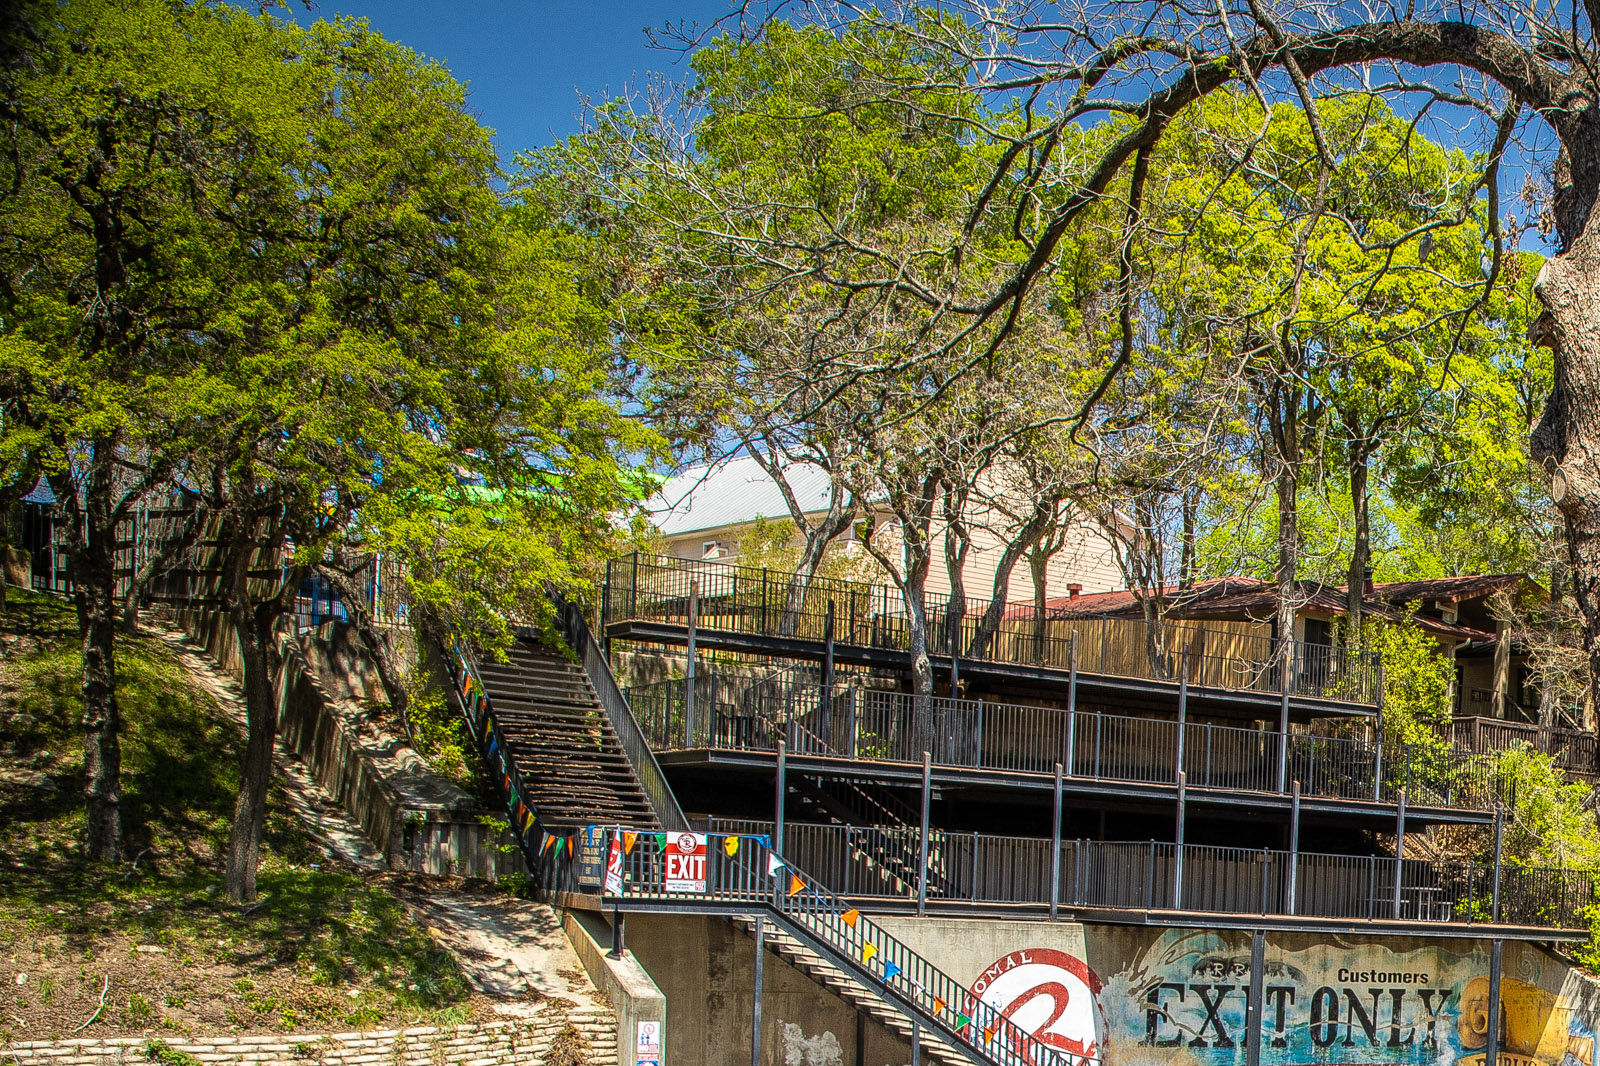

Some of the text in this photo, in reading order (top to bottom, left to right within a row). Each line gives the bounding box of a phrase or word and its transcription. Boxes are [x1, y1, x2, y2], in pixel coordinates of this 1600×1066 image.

[667, 854, 706, 880] EXIT
[1337, 968, 1429, 984] Customers
[1309, 985, 1453, 1048] ONLY
